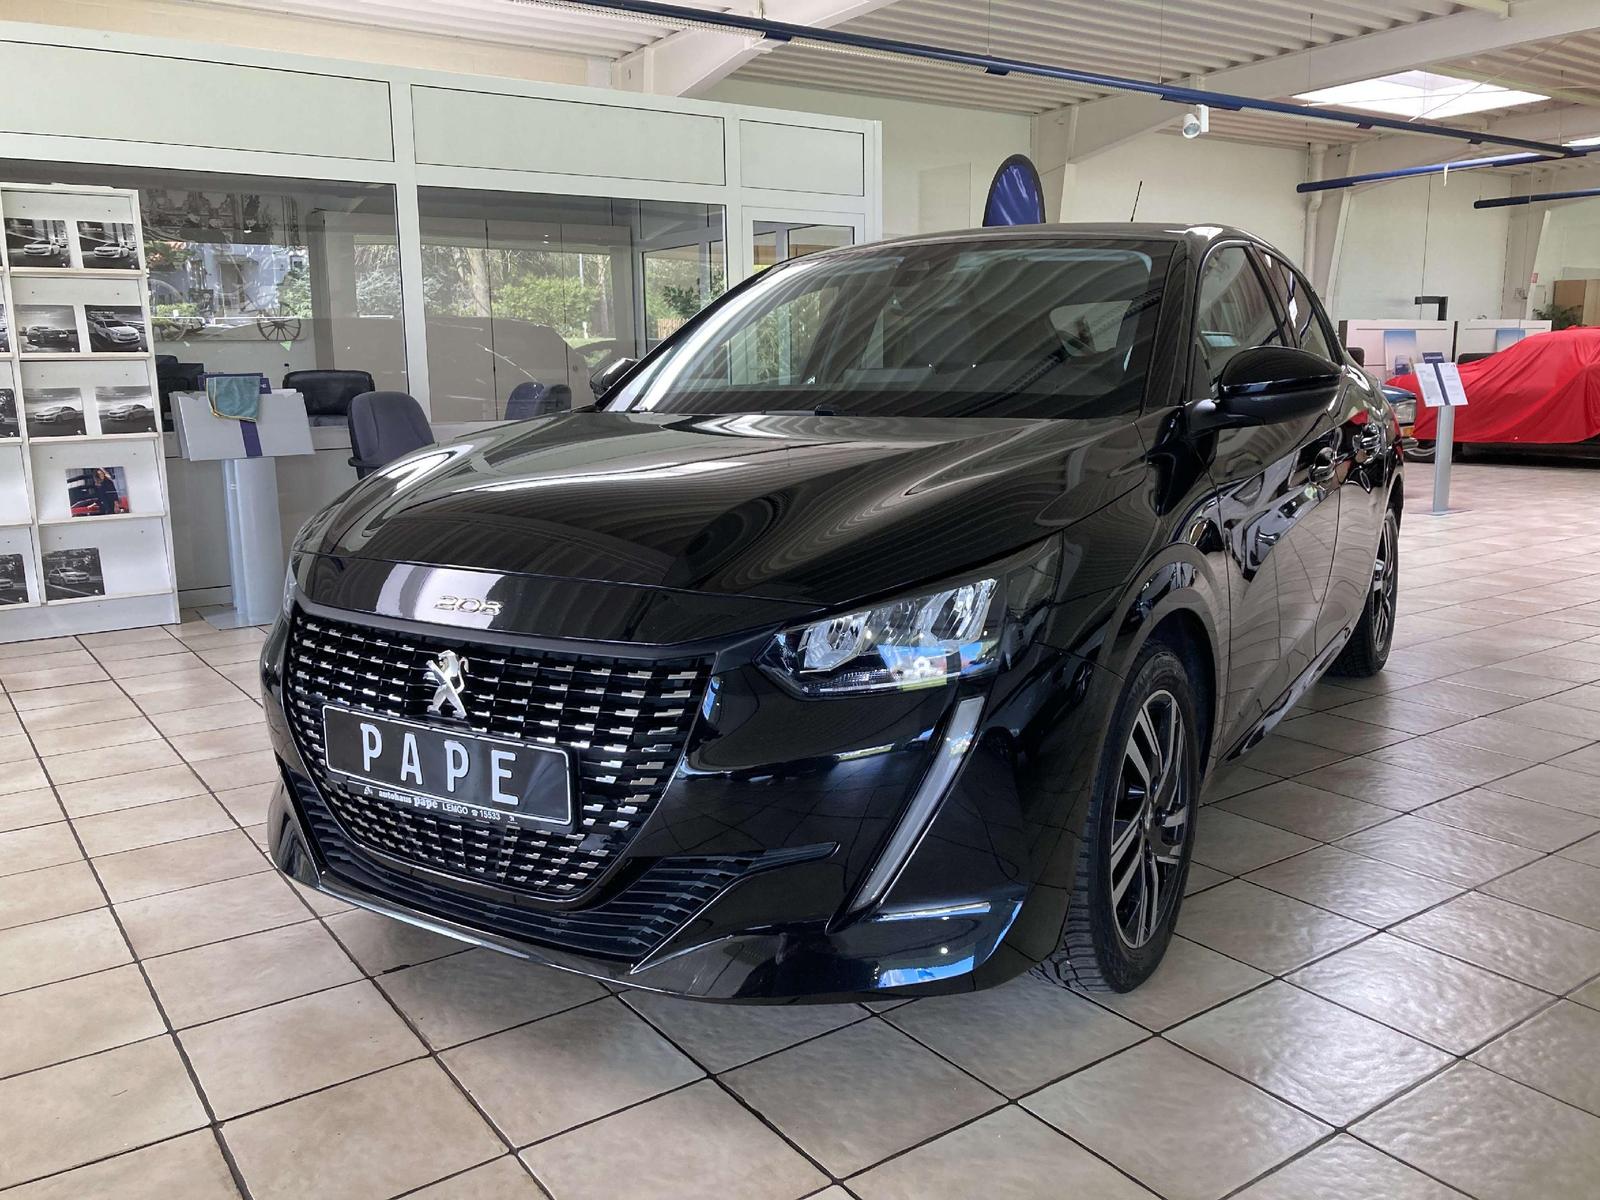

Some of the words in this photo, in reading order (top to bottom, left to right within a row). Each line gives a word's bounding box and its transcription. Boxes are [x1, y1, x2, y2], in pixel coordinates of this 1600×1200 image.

[434, 595, 502, 615] 208
[360, 722, 519, 805] PAPE
[379, 790, 412, 803] autohaus
[413, 796, 438, 809] pape
[442, 803, 468, 814] LEMGO
